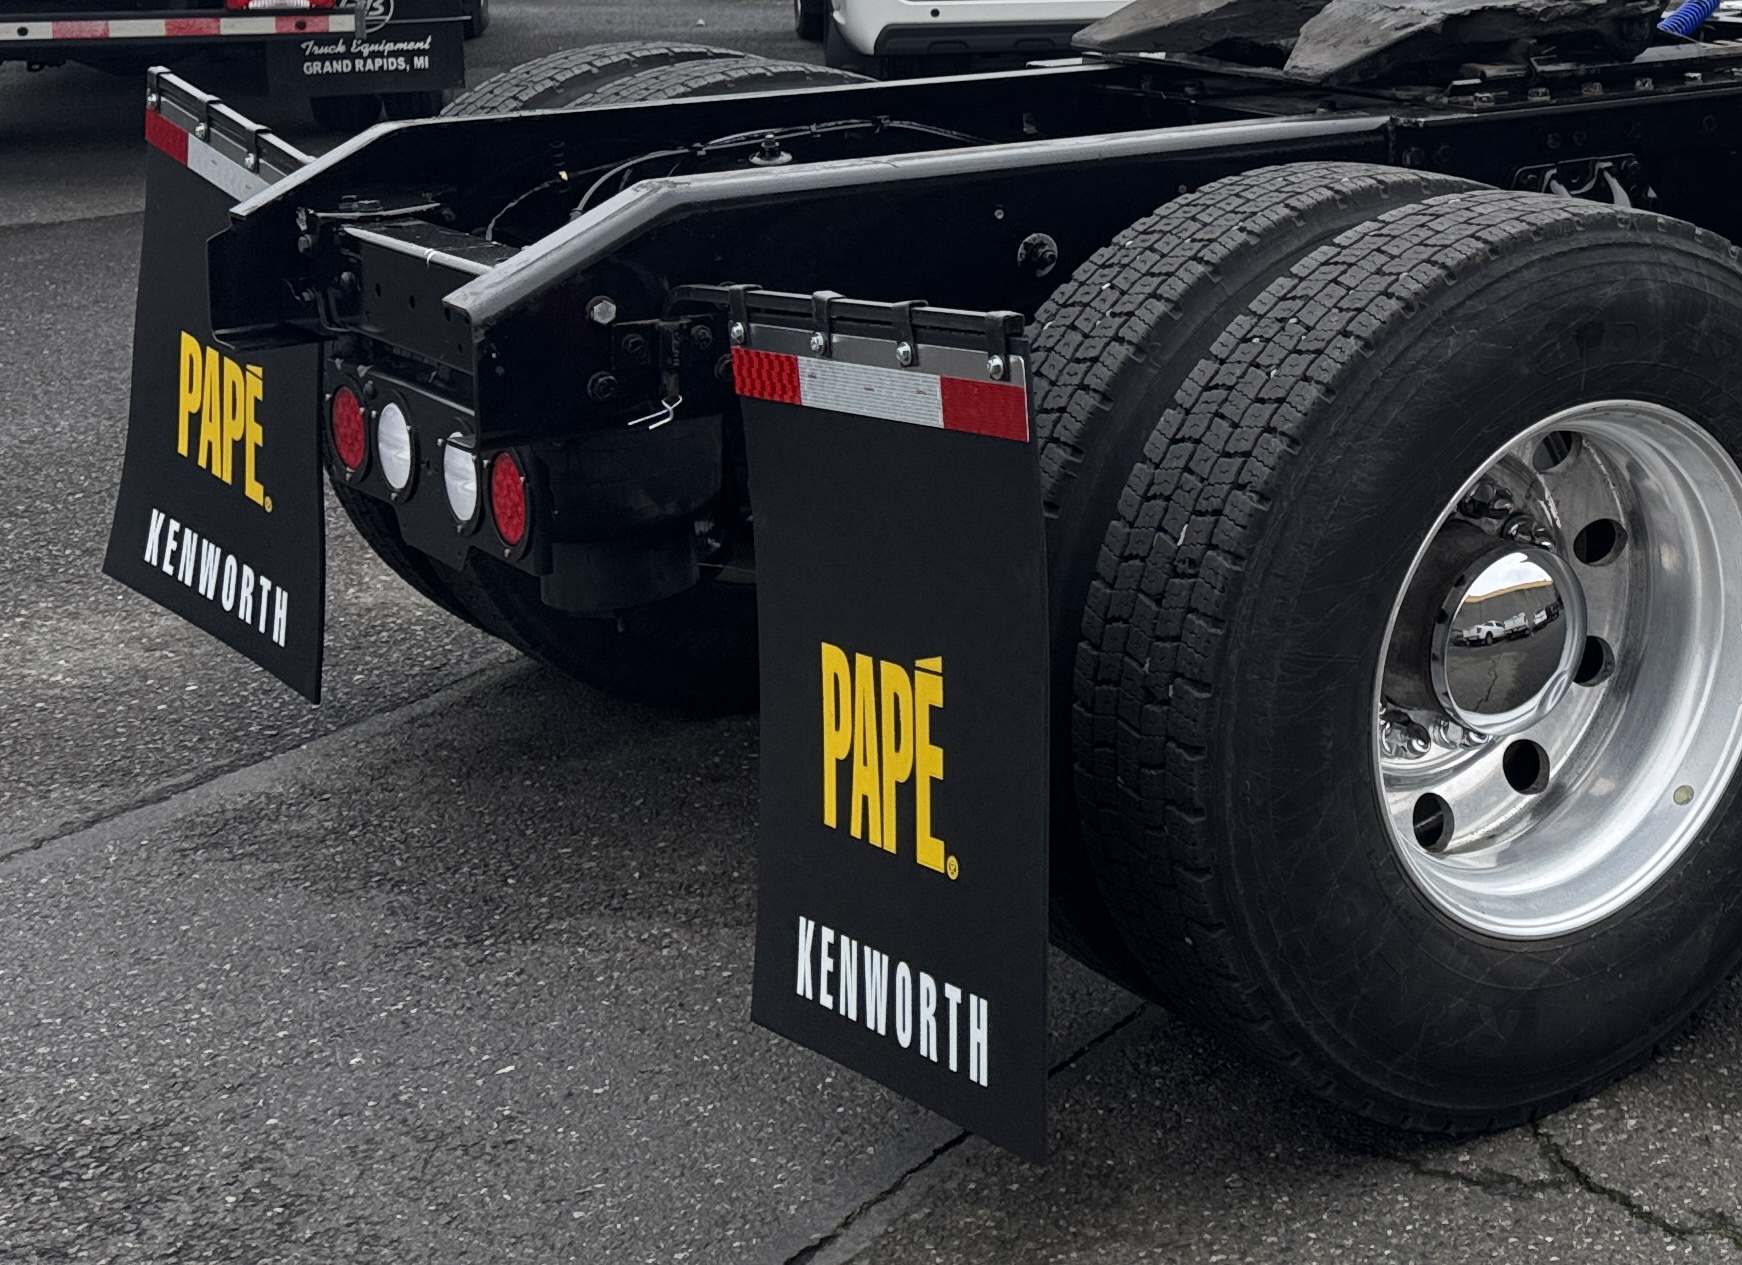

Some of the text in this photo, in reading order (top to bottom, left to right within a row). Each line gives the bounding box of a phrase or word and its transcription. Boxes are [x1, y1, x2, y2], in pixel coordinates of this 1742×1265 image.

[300, 35, 432, 57] Truck Equipment
[303, 55, 429, 75] GRAND RAPIDS, MI
[144, 507, 288, 648] KENWORTH
[796, 915, 989, 1088] KENWORTH
